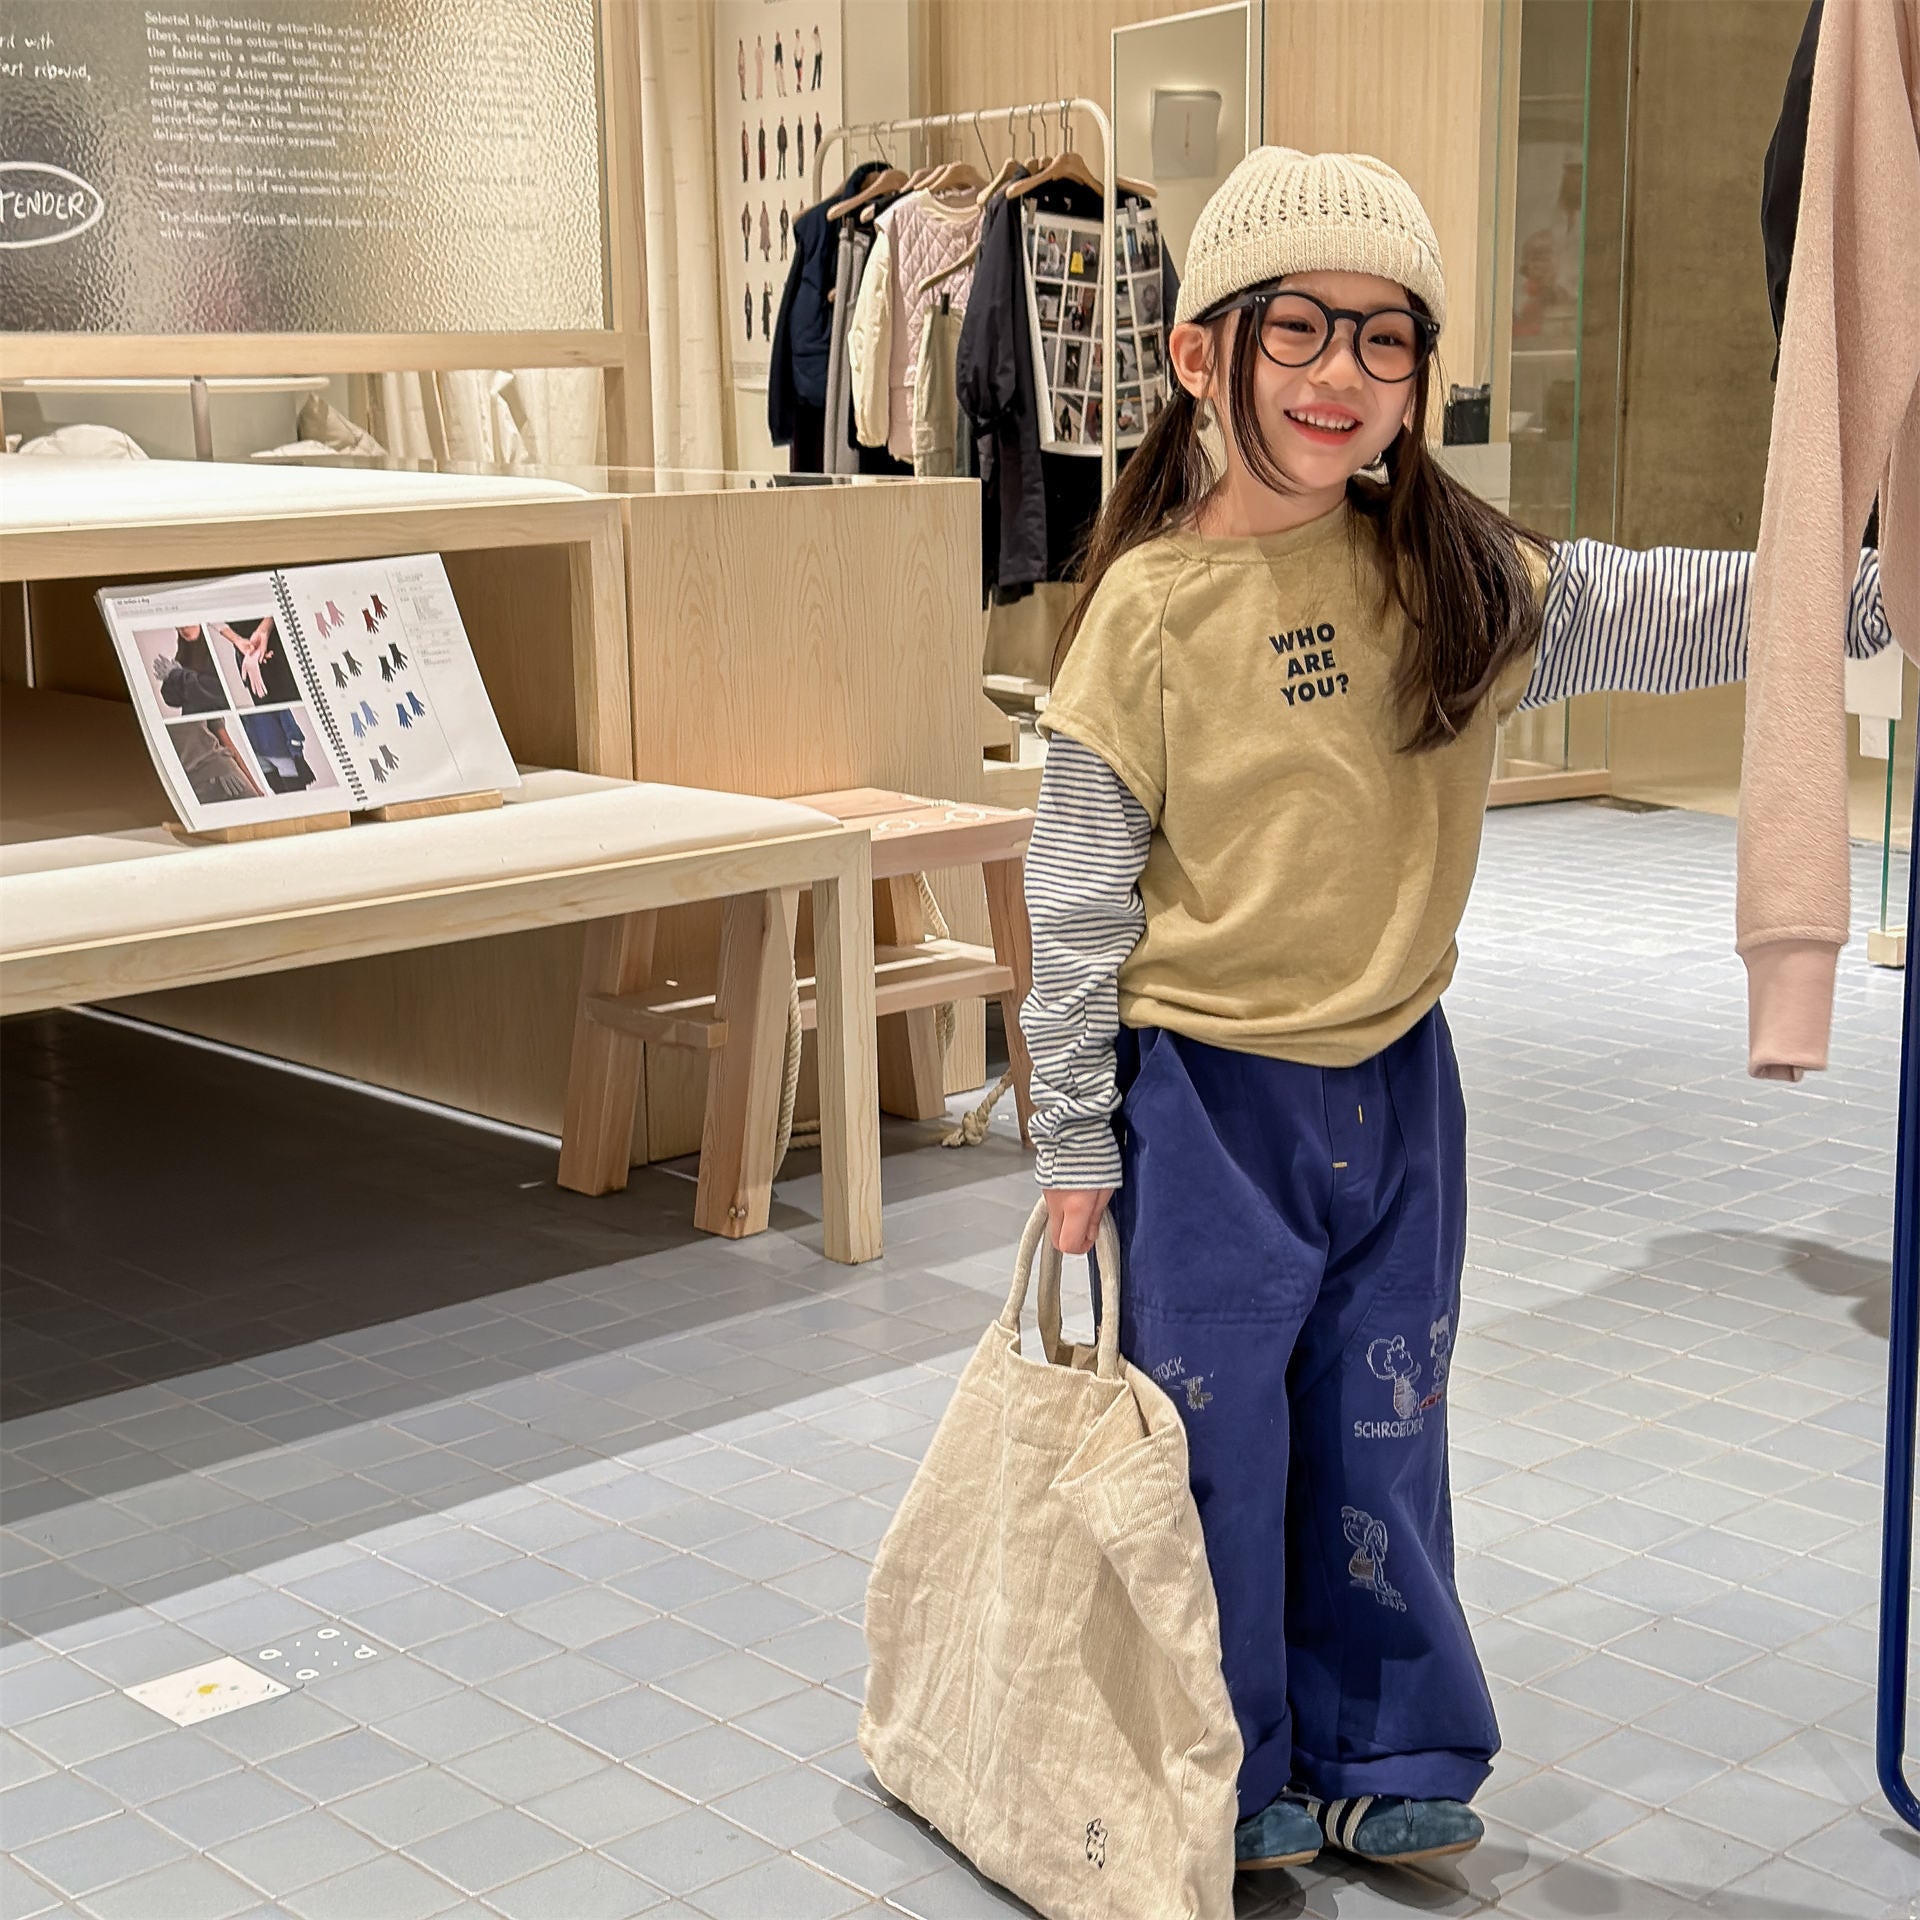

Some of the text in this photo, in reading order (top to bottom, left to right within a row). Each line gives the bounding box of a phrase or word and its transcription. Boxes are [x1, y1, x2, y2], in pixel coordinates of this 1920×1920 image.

[144, 10, 190, 27] Selected
[195, 14, 272, 34] high-elasticity
[277, 21, 333, 36] cotton-like
[24, 30, 55, 50] with
[146, 27, 181, 43] fibers,
[185, 31, 221, 45] retains
[225, 32, 243, 46] the
[246, 36, 304, 51] cotton-like
[147, 44, 167, 58] the
[171, 44, 204, 60] fabric
[208, 48, 233, 62] with
[148, 62, 217, 77] requirements
[219, 64, 231, 79] of
[234, 66, 269, 81] Active
[149, 77, 181, 94] freely
[183, 81, 194, 93] at
[222, 82, 242, 96] and
[242, 82, 282, 101] shaping
[283, 85, 325, 101] stability
[264, 115, 284, 130] the
[154, 160, 191, 176] Cotton
[236, 163, 254, 178] the
[235, 178, 256, 193] full
[257, 179, 269, 194] of
[271, 183, 298, 196] warm
[242, 211, 277, 226] Cotton
[1268, 622, 1337, 656] WHO
[1287, 649, 1337, 680] ARE
[1280, 672, 1349, 707] YOU?
[1353, 1416, 1425, 1440] SCHROEDER
